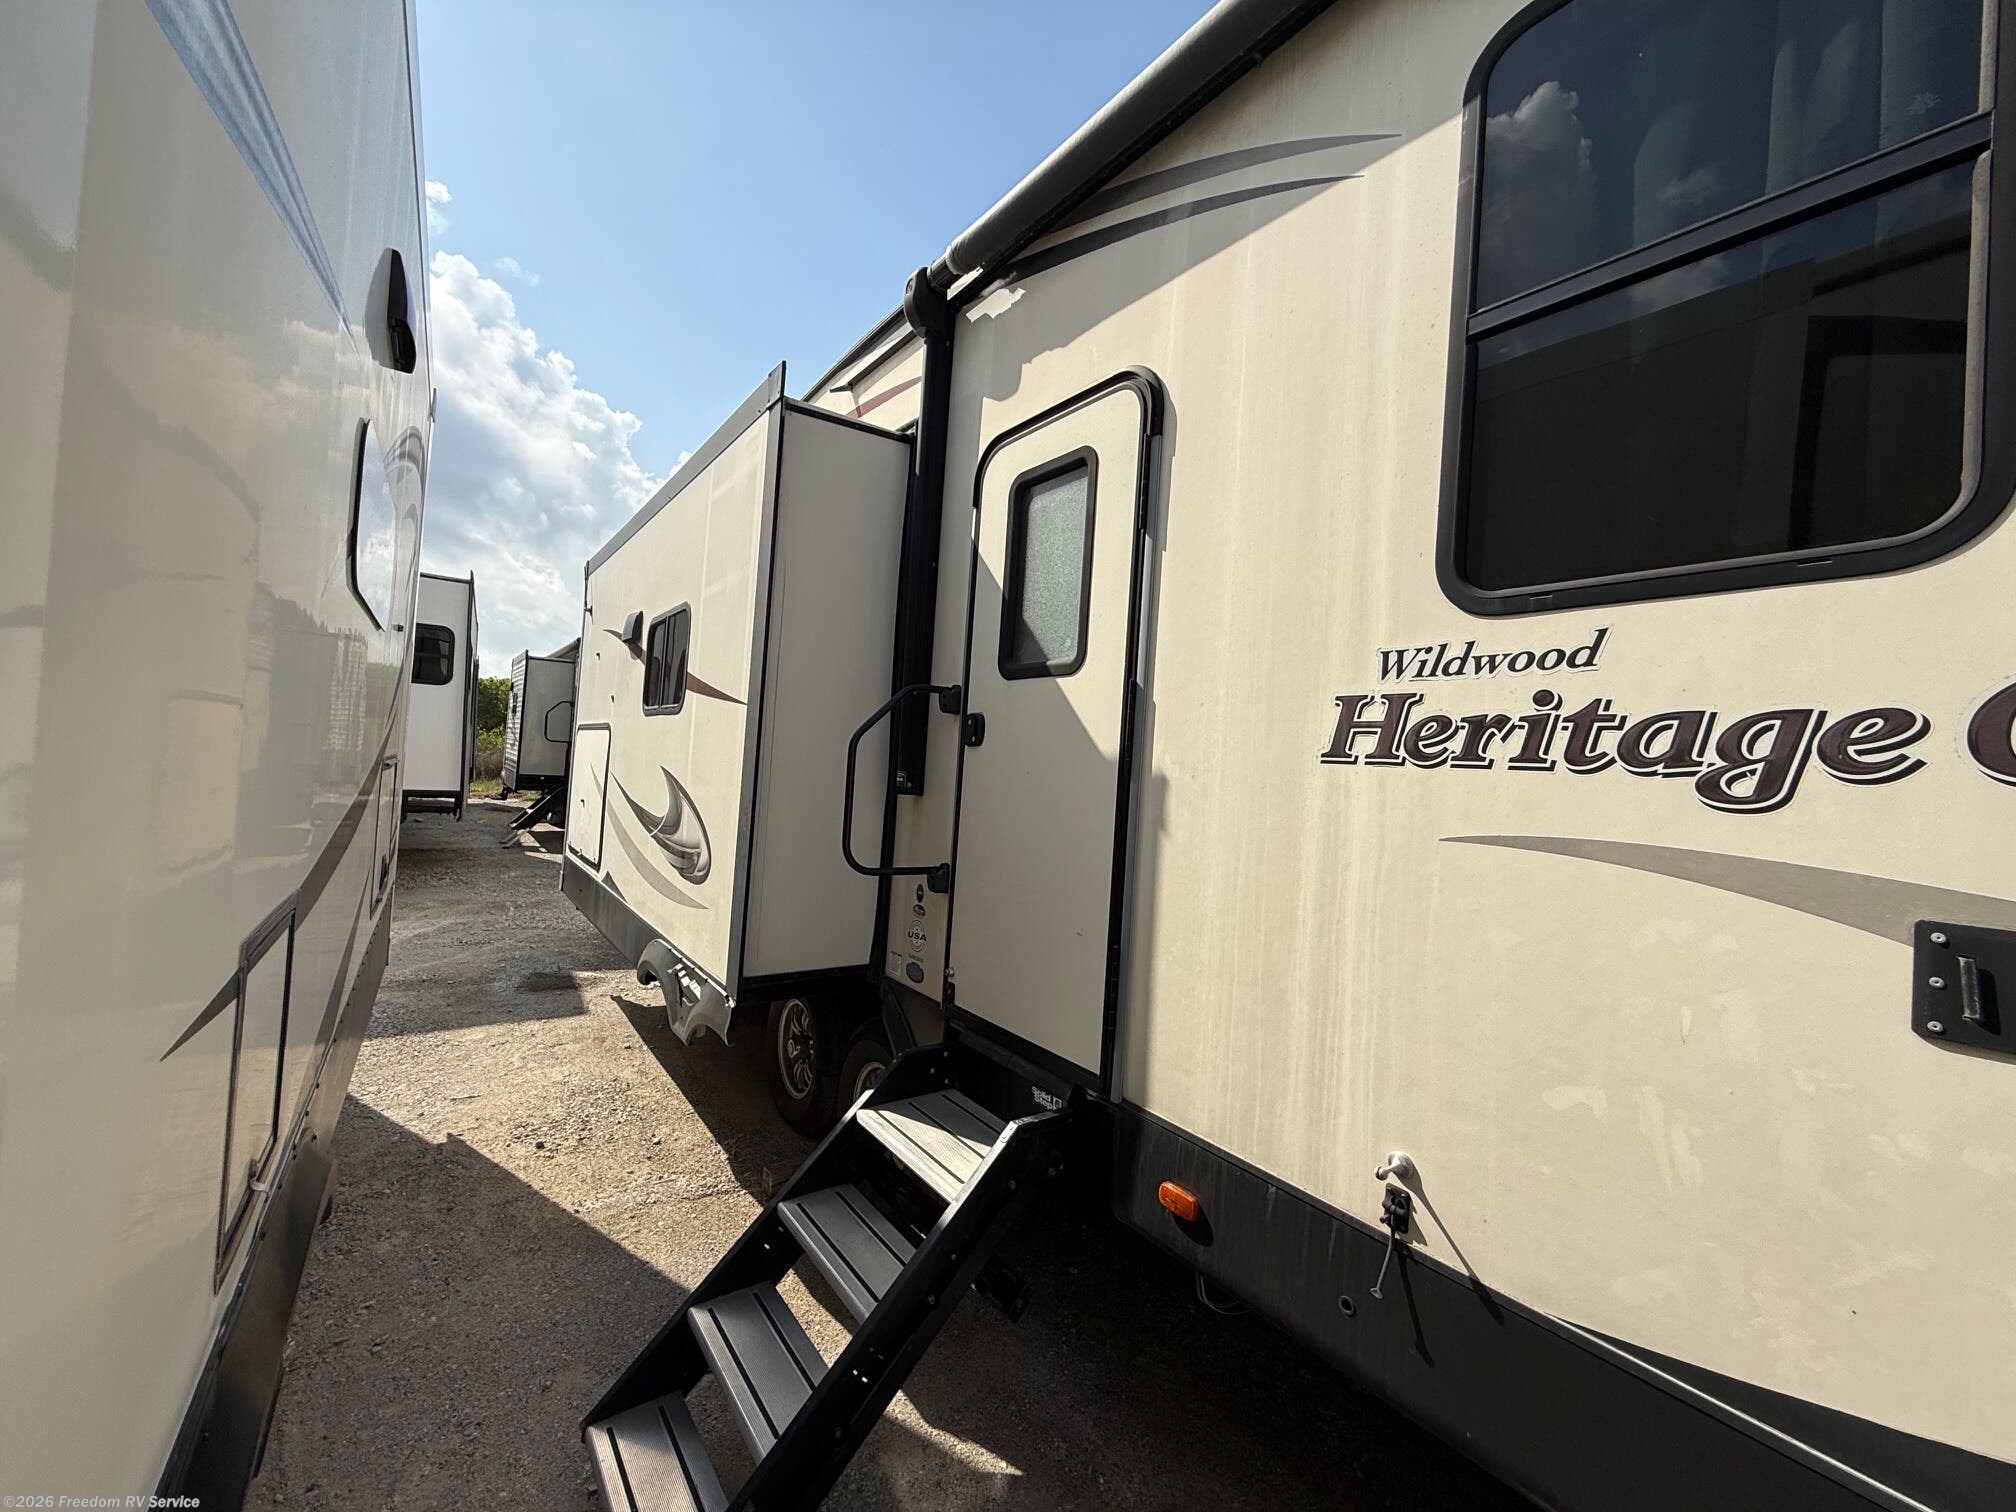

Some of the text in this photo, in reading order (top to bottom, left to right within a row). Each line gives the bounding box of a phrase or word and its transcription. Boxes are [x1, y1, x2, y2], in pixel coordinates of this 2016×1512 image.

[1379, 626, 1609, 683] Wildwood
[1320, 688, 1932, 815] Heritage
[907, 931, 927, 942] USA
[1034, 1095, 1053, 1110] Step
